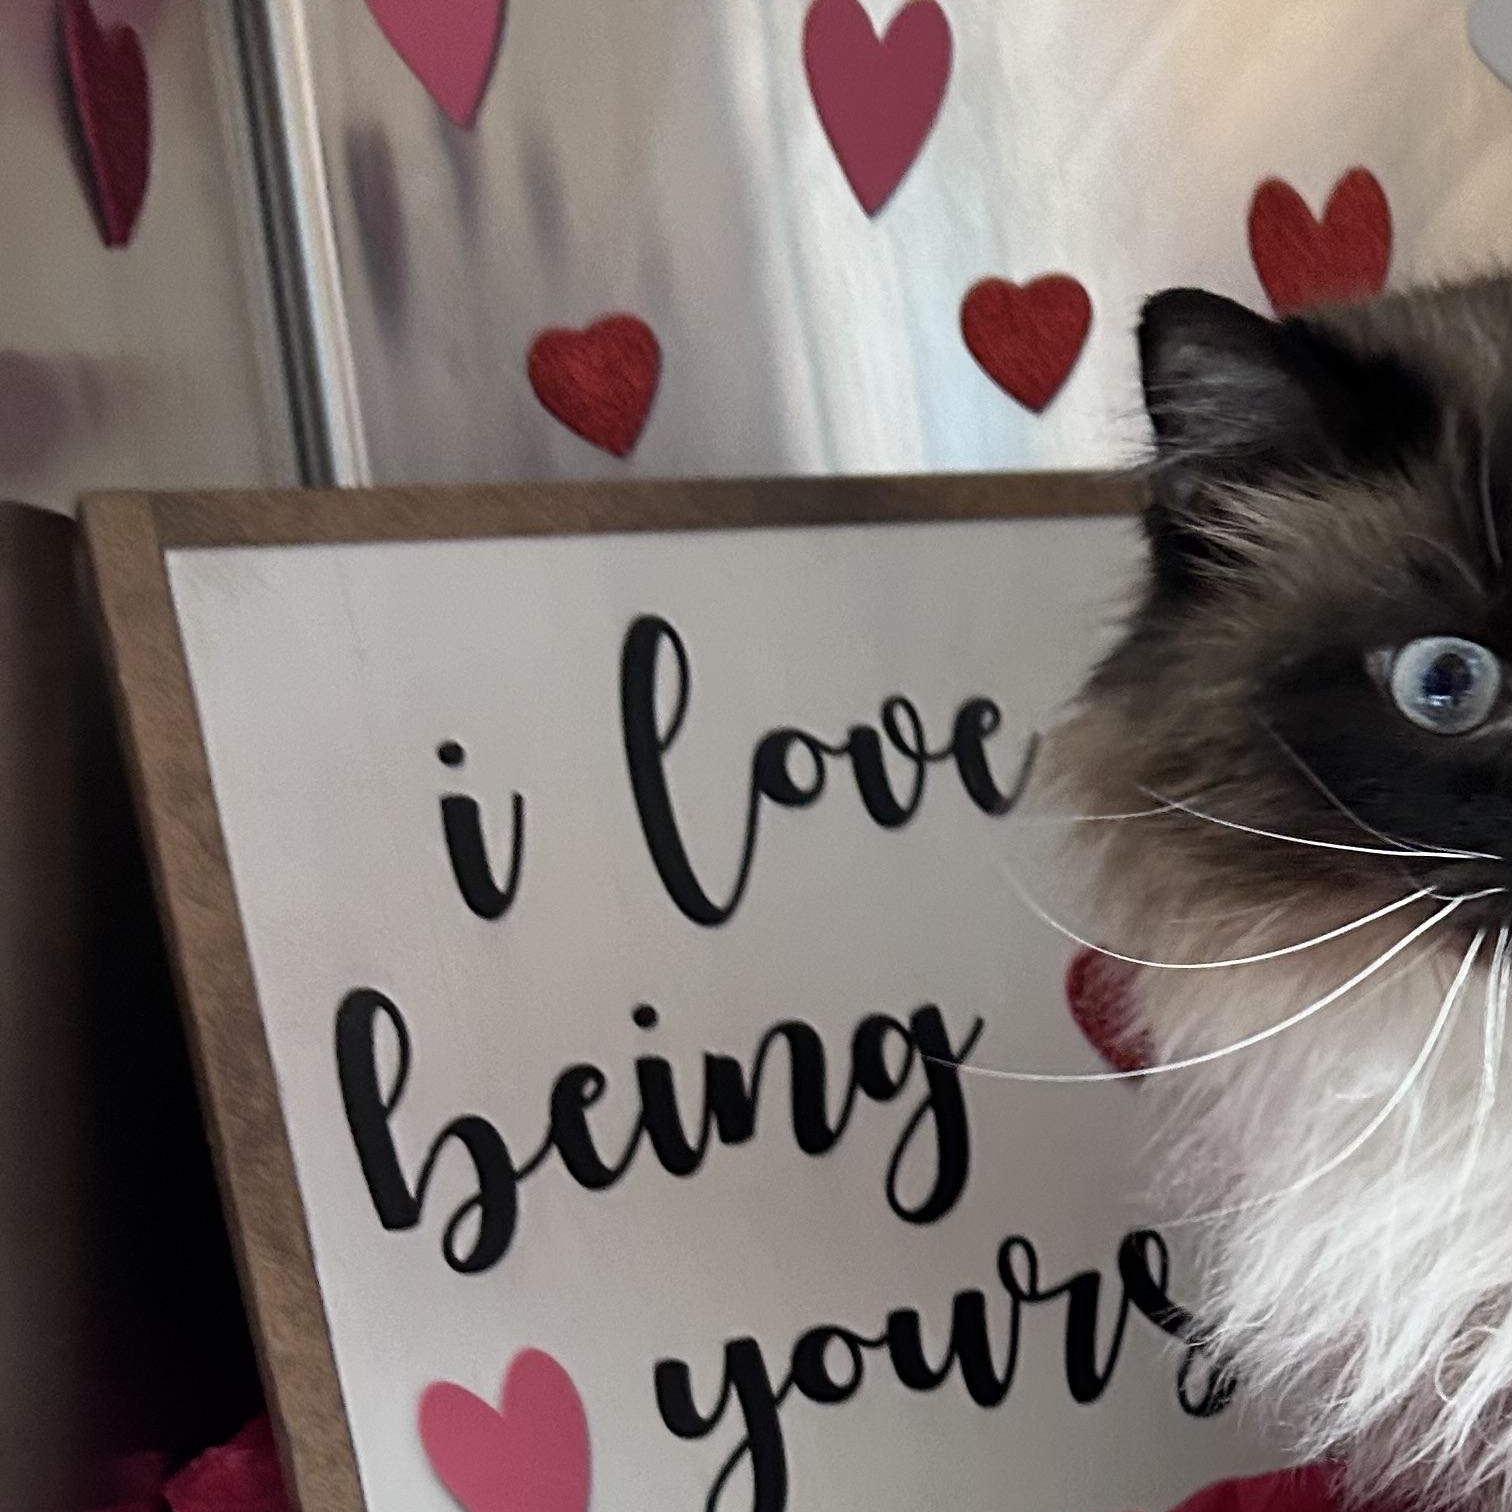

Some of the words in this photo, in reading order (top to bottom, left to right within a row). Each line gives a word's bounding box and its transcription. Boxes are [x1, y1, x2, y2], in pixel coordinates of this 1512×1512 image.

[437, 741, 524, 921] i
[619, 614, 1040, 928] love
[334, 987, 984, 1275] being
